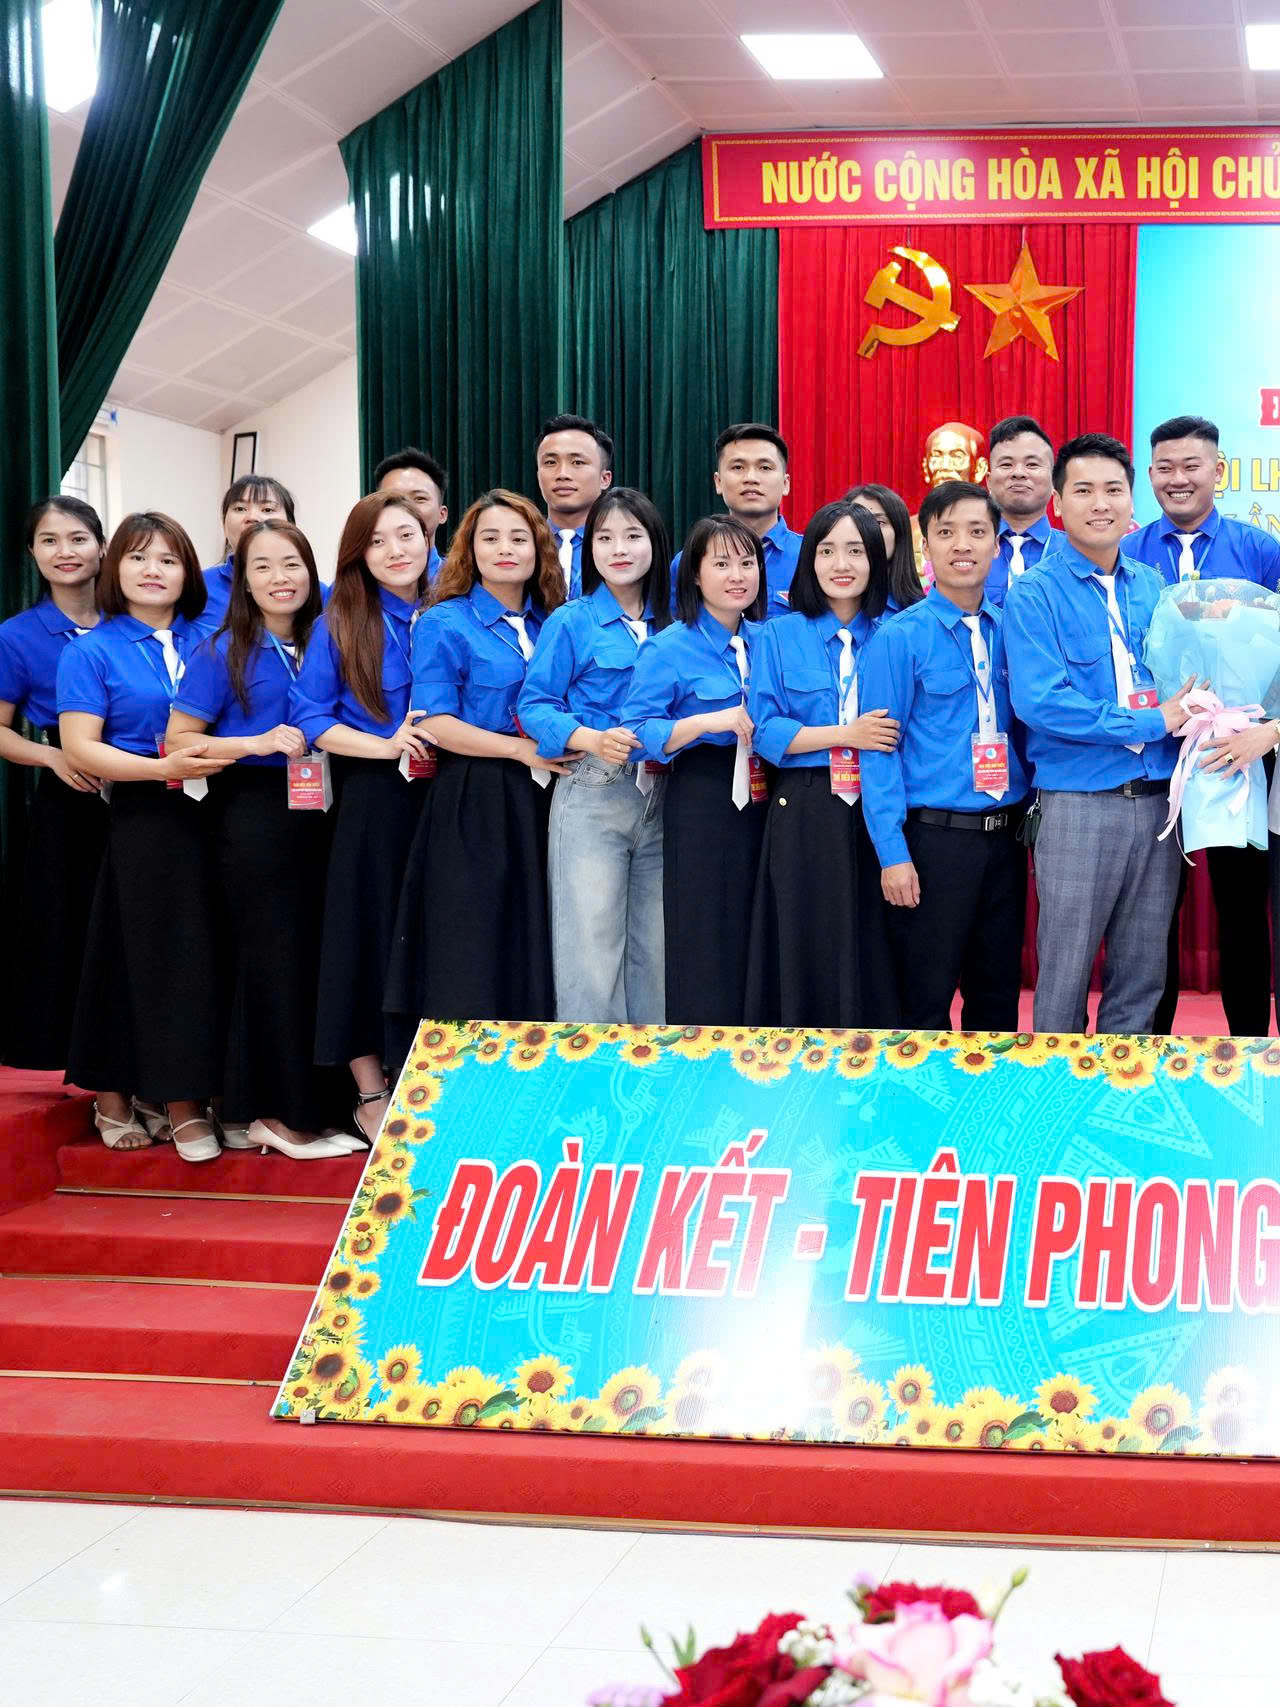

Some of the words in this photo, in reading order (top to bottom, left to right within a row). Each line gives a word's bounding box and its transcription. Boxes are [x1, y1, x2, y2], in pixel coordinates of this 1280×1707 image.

[762, 150, 862, 205] NƯỚC
[874, 149, 976, 211] CỘNG
[988, 150, 1063, 201] HÒA
[1075, 148, 1126, 200] XÃ
[1137, 147, 1199, 208] HỘI
[419, 1140, 642, 1291] ĐOÀN
[635, 1132, 791, 1295] KẾT
[846, 1150, 1016, 1302] TIÊN
